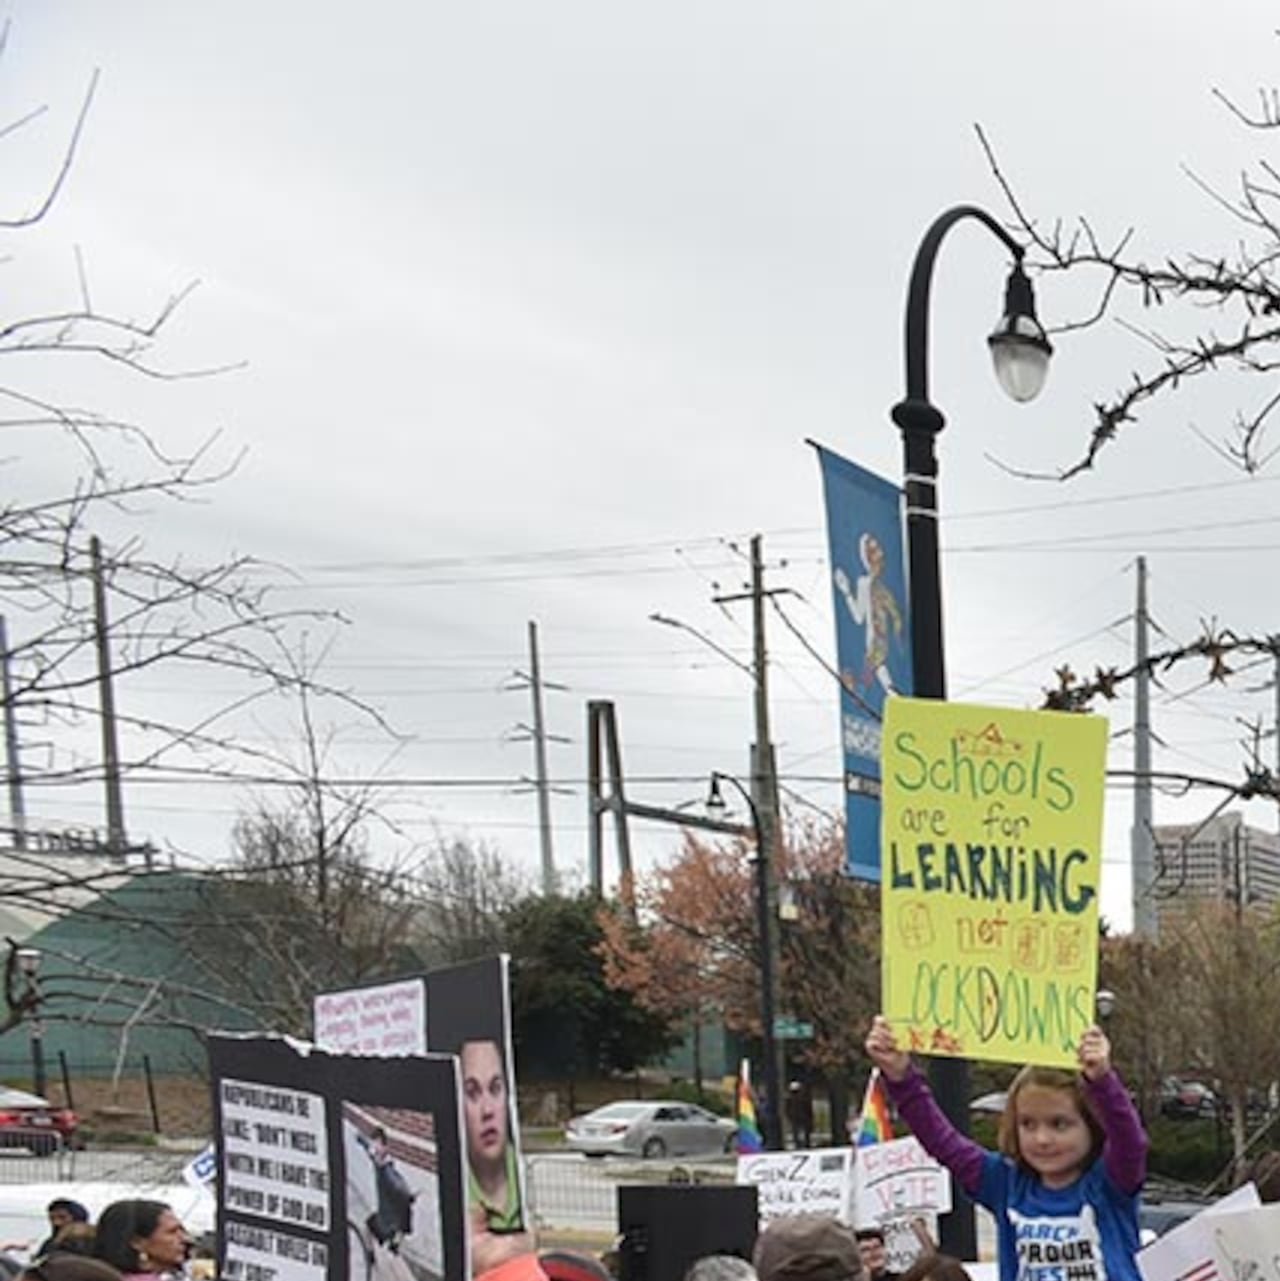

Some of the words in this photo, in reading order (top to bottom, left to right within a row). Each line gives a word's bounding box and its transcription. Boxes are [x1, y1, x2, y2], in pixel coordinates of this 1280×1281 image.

[894, 731, 1075, 811] Schools
[901, 806, 947, 837] are
[983, 801, 1030, 840] for
